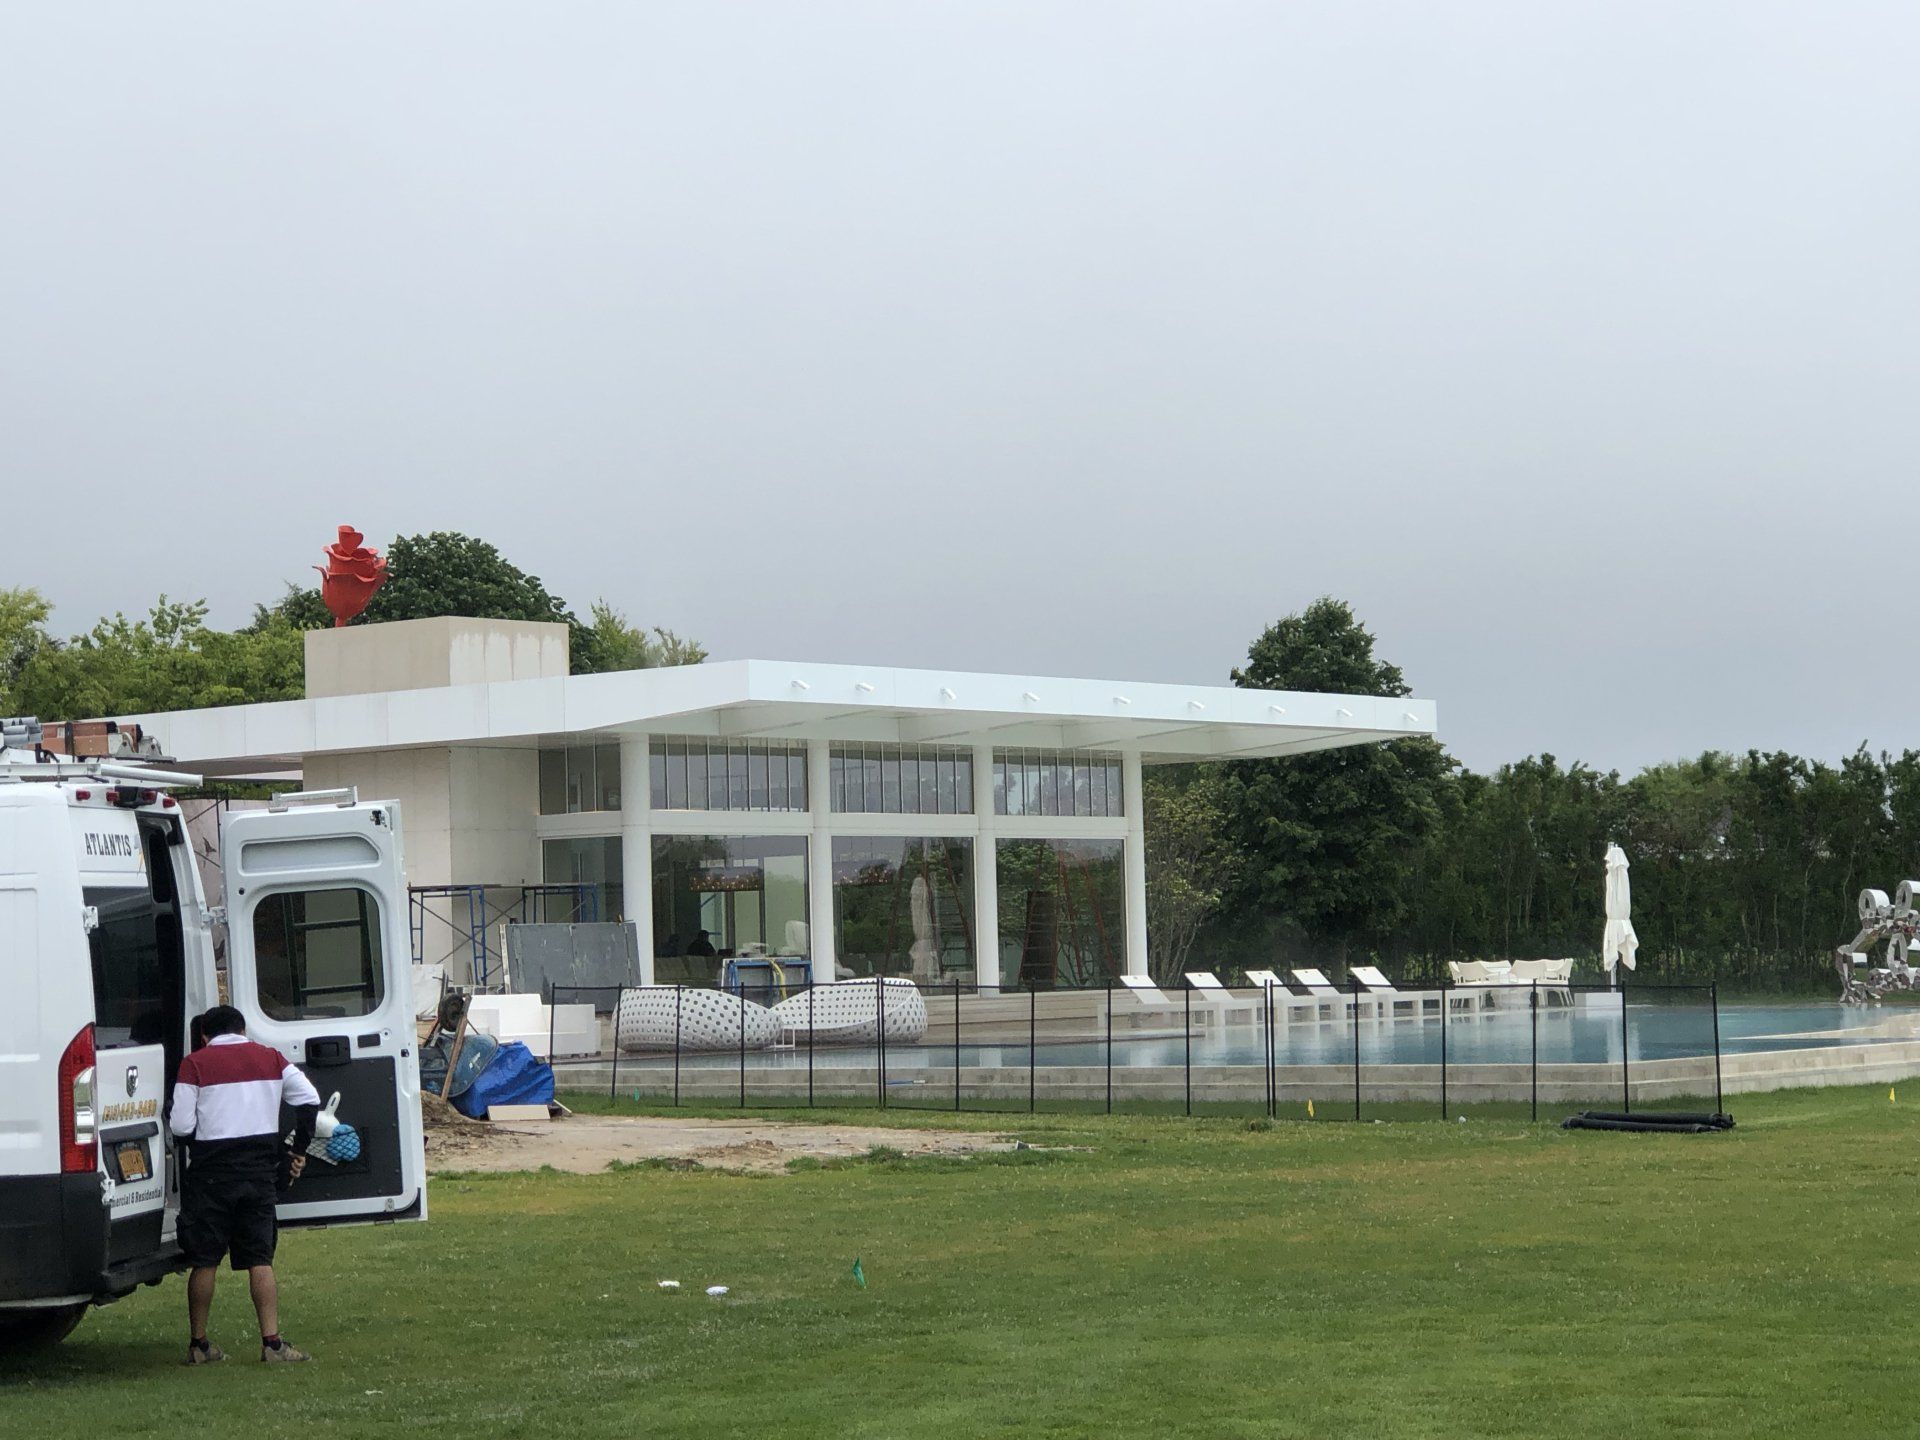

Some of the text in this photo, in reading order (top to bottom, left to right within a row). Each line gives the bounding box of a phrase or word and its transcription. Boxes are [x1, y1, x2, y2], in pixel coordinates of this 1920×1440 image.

[84, 832, 132, 857] ATLANTIS
[110, 1193, 130, 1208] mercial
[135, 1186, 163, 1203] Residential
